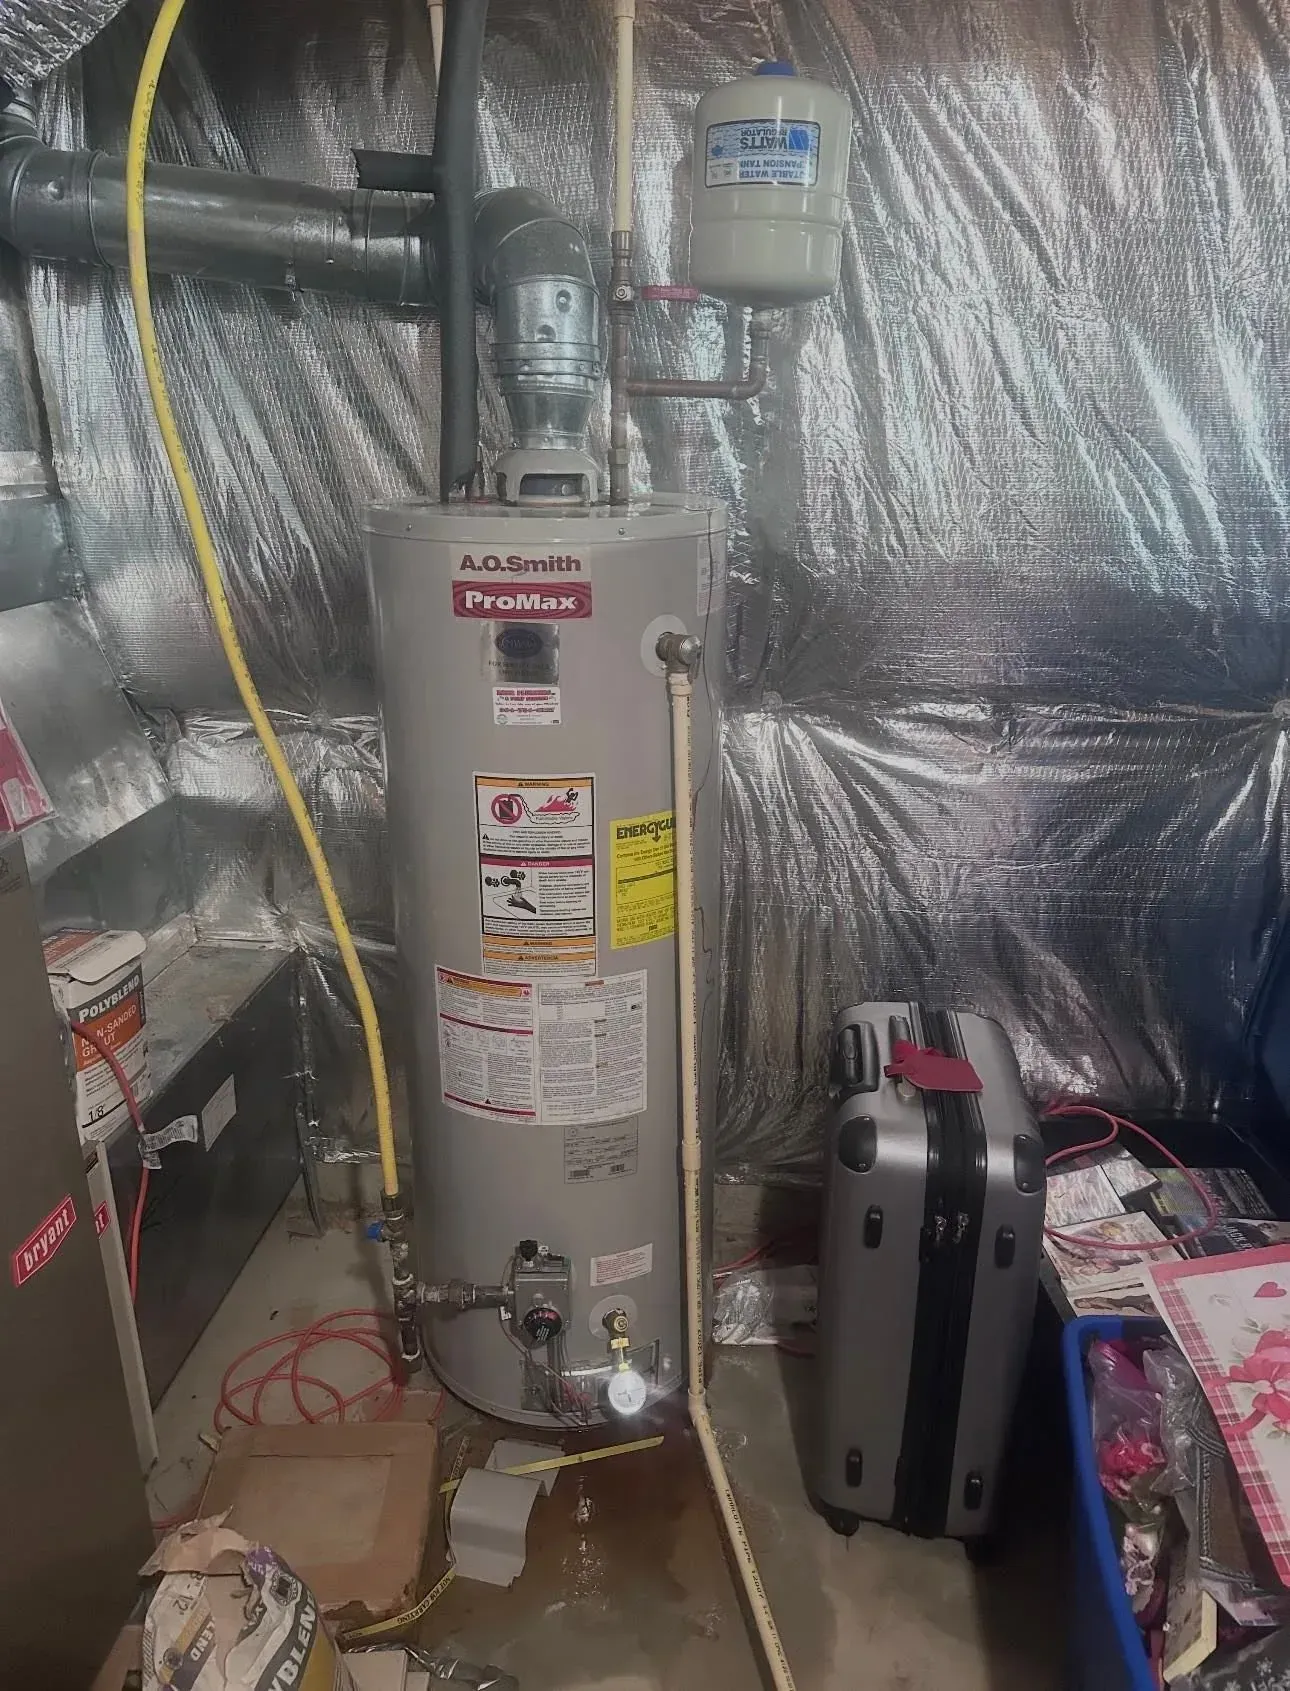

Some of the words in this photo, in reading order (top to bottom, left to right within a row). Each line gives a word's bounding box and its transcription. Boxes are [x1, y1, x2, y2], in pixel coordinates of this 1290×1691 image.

[740, 137, 788, 150] WATTS
[740, 169, 769, 178] WATER
[460, 554, 581, 573] A.O.Smith
[465, 590, 577, 610] ProMax
[616, 817, 676, 841] ENERGYGU
[79, 975, 139, 1023] POLYBLEND
[81, 1005, 137, 1047] NN-SANDED
[23, 1208, 70, 1271] bryant
[751, 1569, 764, 1599] 12007
